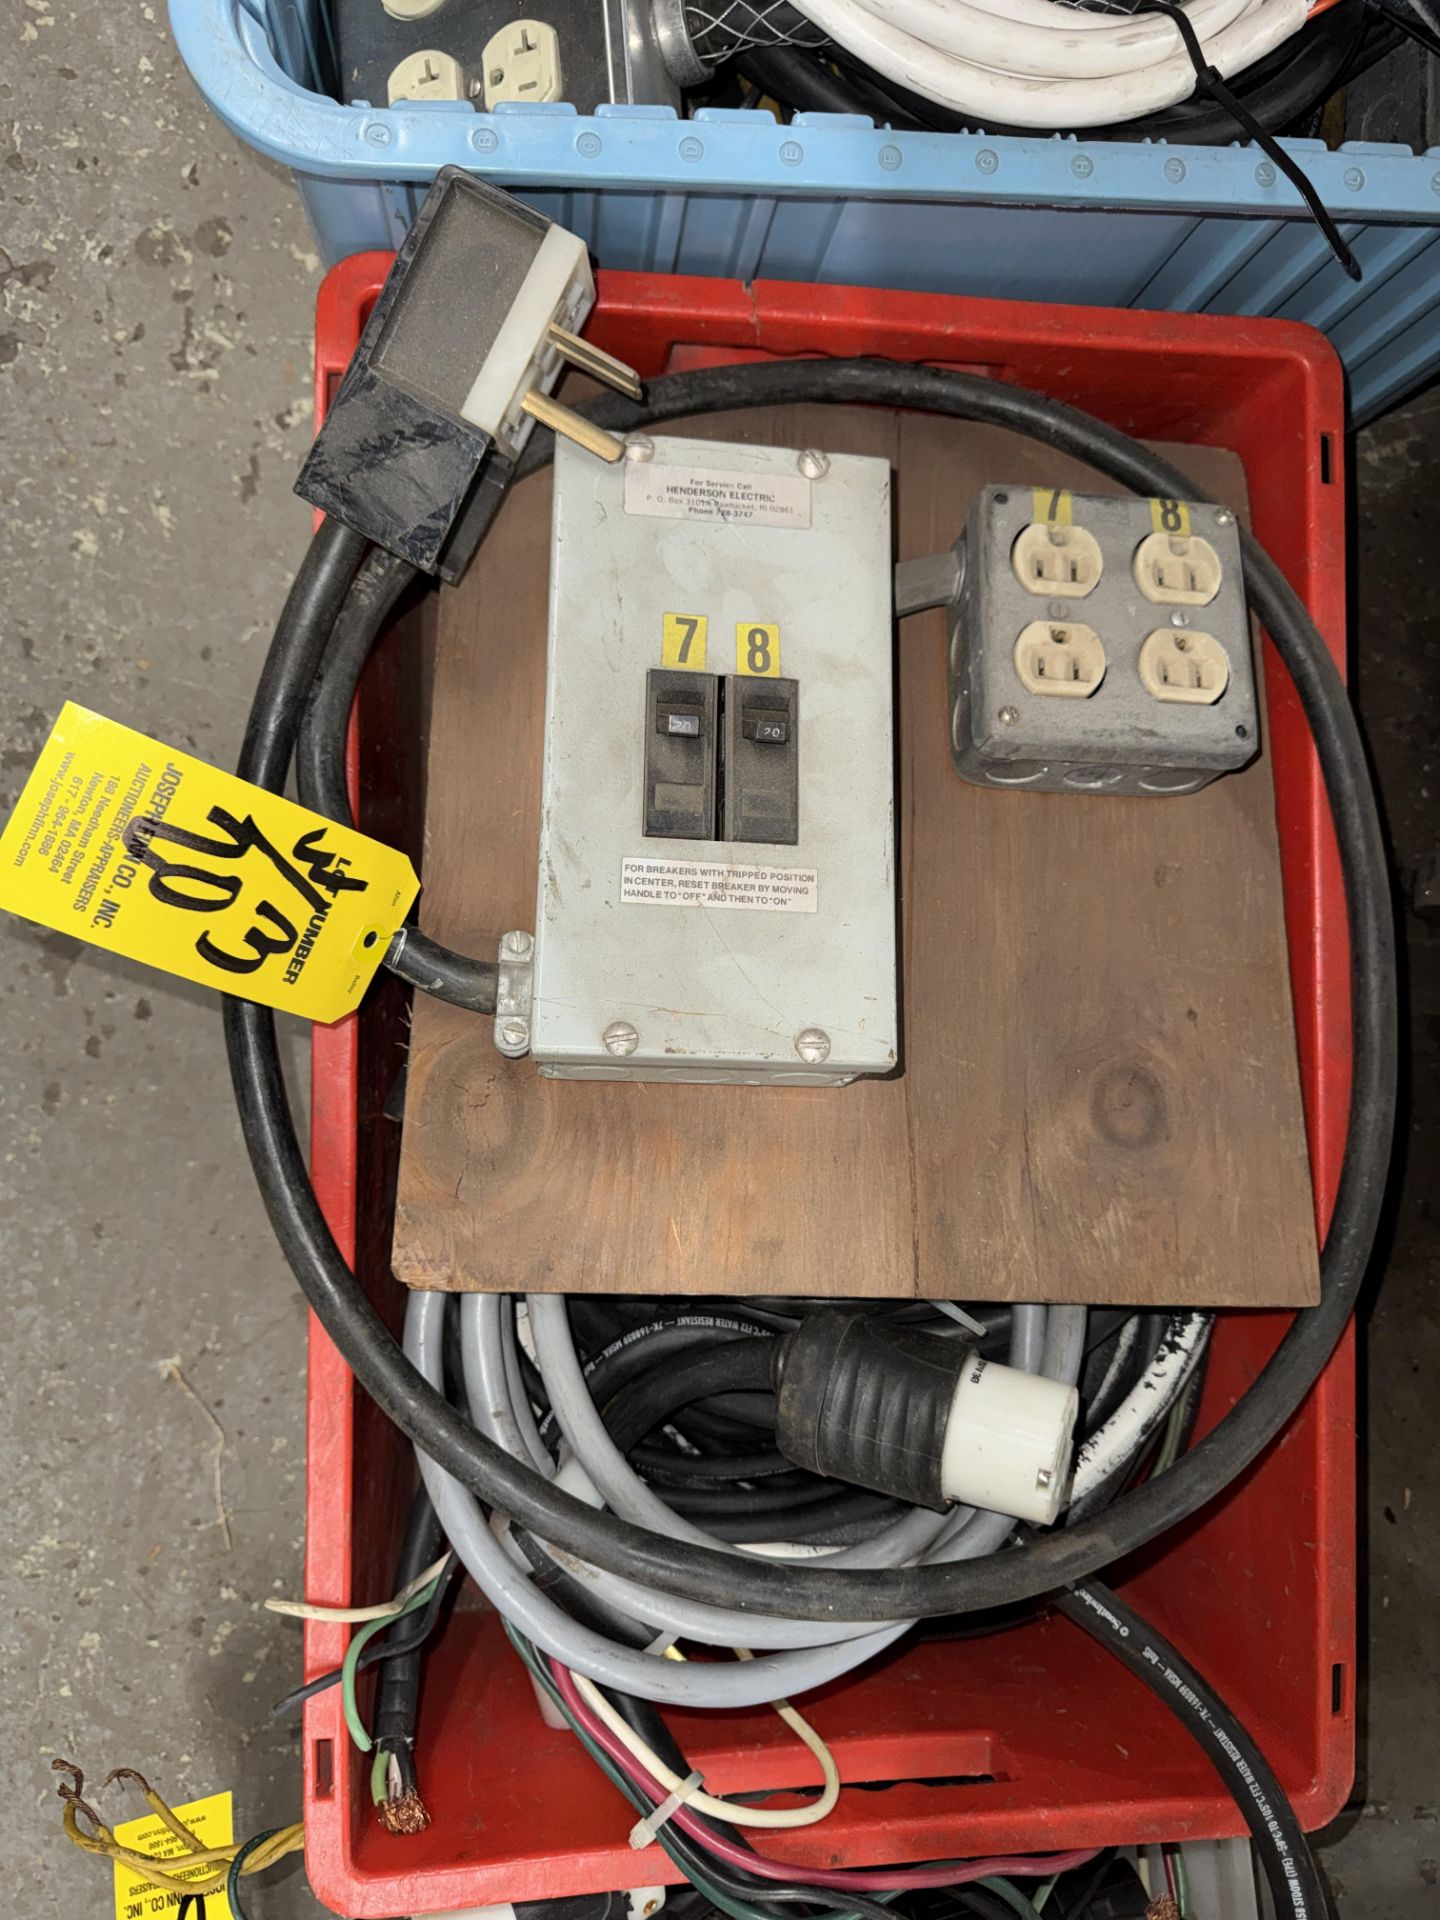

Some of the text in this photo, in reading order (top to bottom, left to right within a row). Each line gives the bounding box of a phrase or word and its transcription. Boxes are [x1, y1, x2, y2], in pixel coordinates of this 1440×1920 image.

[666, 486, 775, 503] HENDERSON ELECTRIC
[688, 506, 713, 515] Phone
[1159, 499, 1182, 532] 8
[675, 617, 698, 663] 7
[747, 628, 771, 673] 8
[763, 726, 780, 738] 20
[67, 776, 83, 798] 617
[140, 763, 183, 828] JOSEPH
[13, 752, 75, 867] www.josephfinn.com
[48, 771, 104, 873] Newton, MA 02464
[78, 796, 111, 848] Needham
[38, 805, 69, 856] 964-1886
[73, 763, 151, 912] AUCTIONEERS-APPRAISERS
[127, 824, 155, 863] FINN
[60, 850, 85, 884] Street
[624, 864, 815, 883] FOR BREAKERS WITH TRIPPED POSITION
[623, 876, 809, 895] IN CENTER, RESET BREAKER BY MOVING
[623, 889, 662, 899] HANDLE
[664, 890, 677, 900] TO
[707, 893, 727, 902] AND
[728, 894, 754, 904] THEN
[756, 896, 769, 905] TO
[91, 898, 120, 928] INC.
[283, 898, 332, 985] NUMBER
[677, 1316, 714, 1326] RESISTANT
[715, 1318, 739, 1330] WATER
[1164, 1668, 1182, 1688] MSHA
[1179, 1685, 1210, 1720] 7K-168039
[1214, 1728, 1241, 1761] RESISTANT
[1236, 1759, 1255, 1784] WATER
[1249, 1782, 1262, 1797] FT2
[1268, 1821, 1279, 1832] TO
[1282, 1858, 1298, 1877] (TPE)
[124, 1902, 143, 1919] INC.
